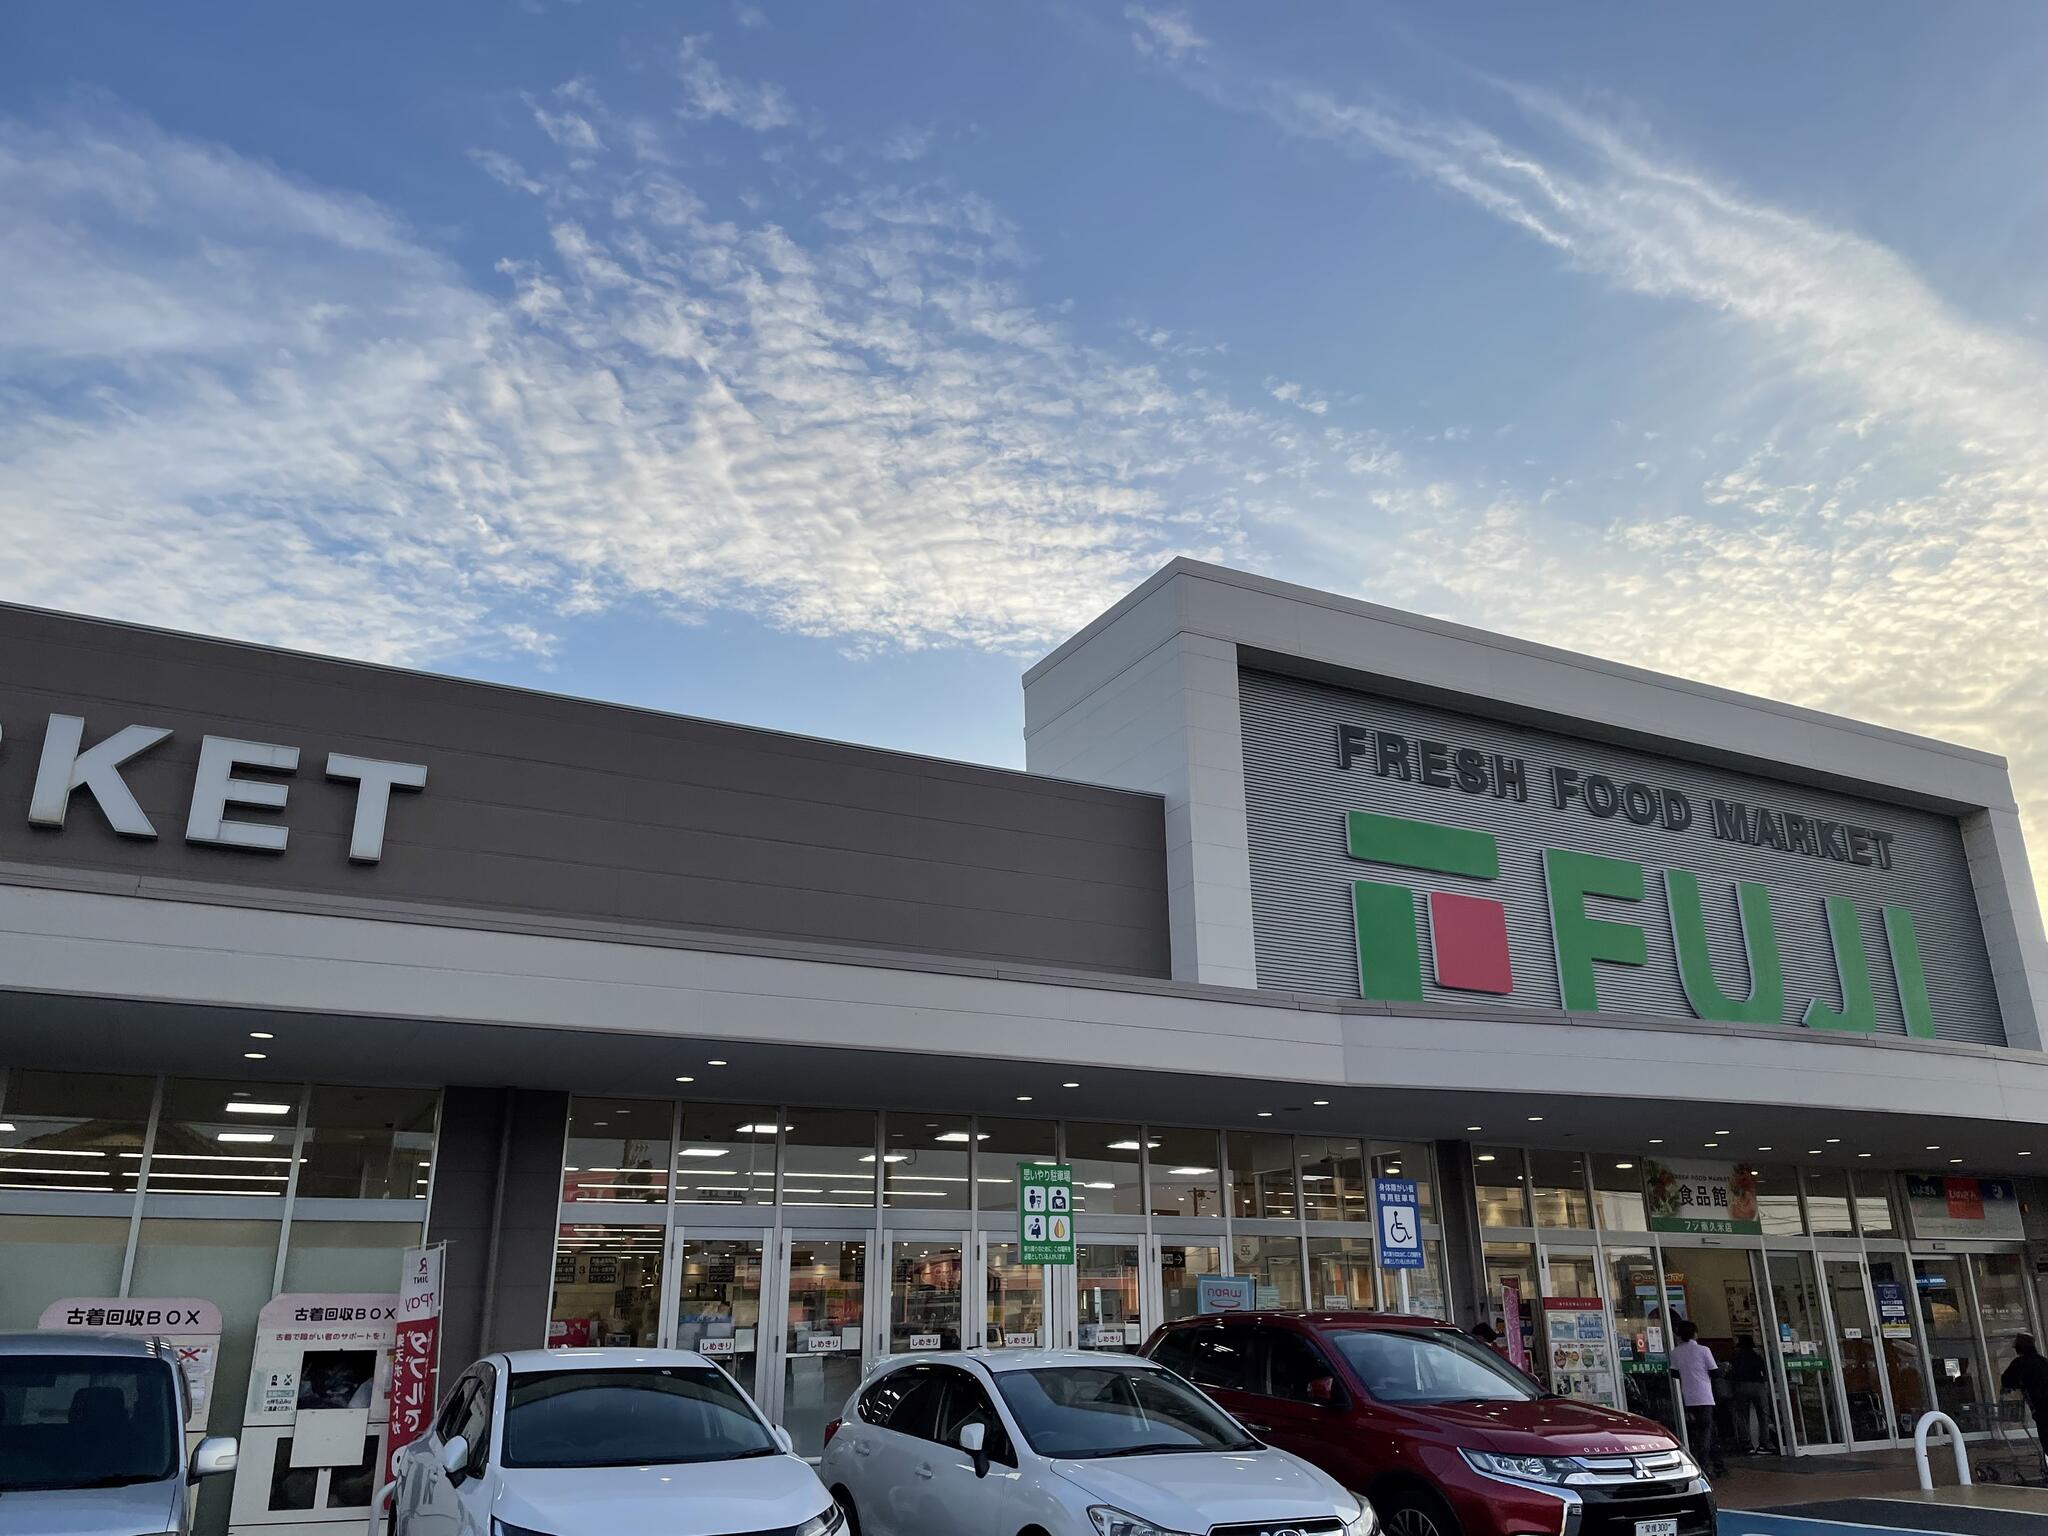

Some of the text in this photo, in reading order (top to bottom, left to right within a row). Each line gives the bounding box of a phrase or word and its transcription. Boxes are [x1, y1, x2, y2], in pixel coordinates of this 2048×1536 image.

[0, 713, 428, 863] KET
[1336, 723, 1893, 870] FRESH FOOD MARKET
[1542, 847, 1935, 1039] FUJI
[1023, 1168, 1070, 1182] 思いやり駐車場
[1380, 1193, 1416, 1202] 専用駐車場
[1679, 1185, 1728, 1206] 食品館
[67, 1307, 201, 1327] 古着回収BOX
[295, 1306, 397, 1321] 古着回収BOX
[810, 1340, 839, 1349] しめきり
[912, 1338, 938, 1346] しめきり
[1007, 1336, 1033, 1344] しめきり
[1097, 1335, 1122, 1343] しめきり
[702, 1342, 732, 1351] しめきり
[1583, 1442, 1661, 1453] OUTLANDER
